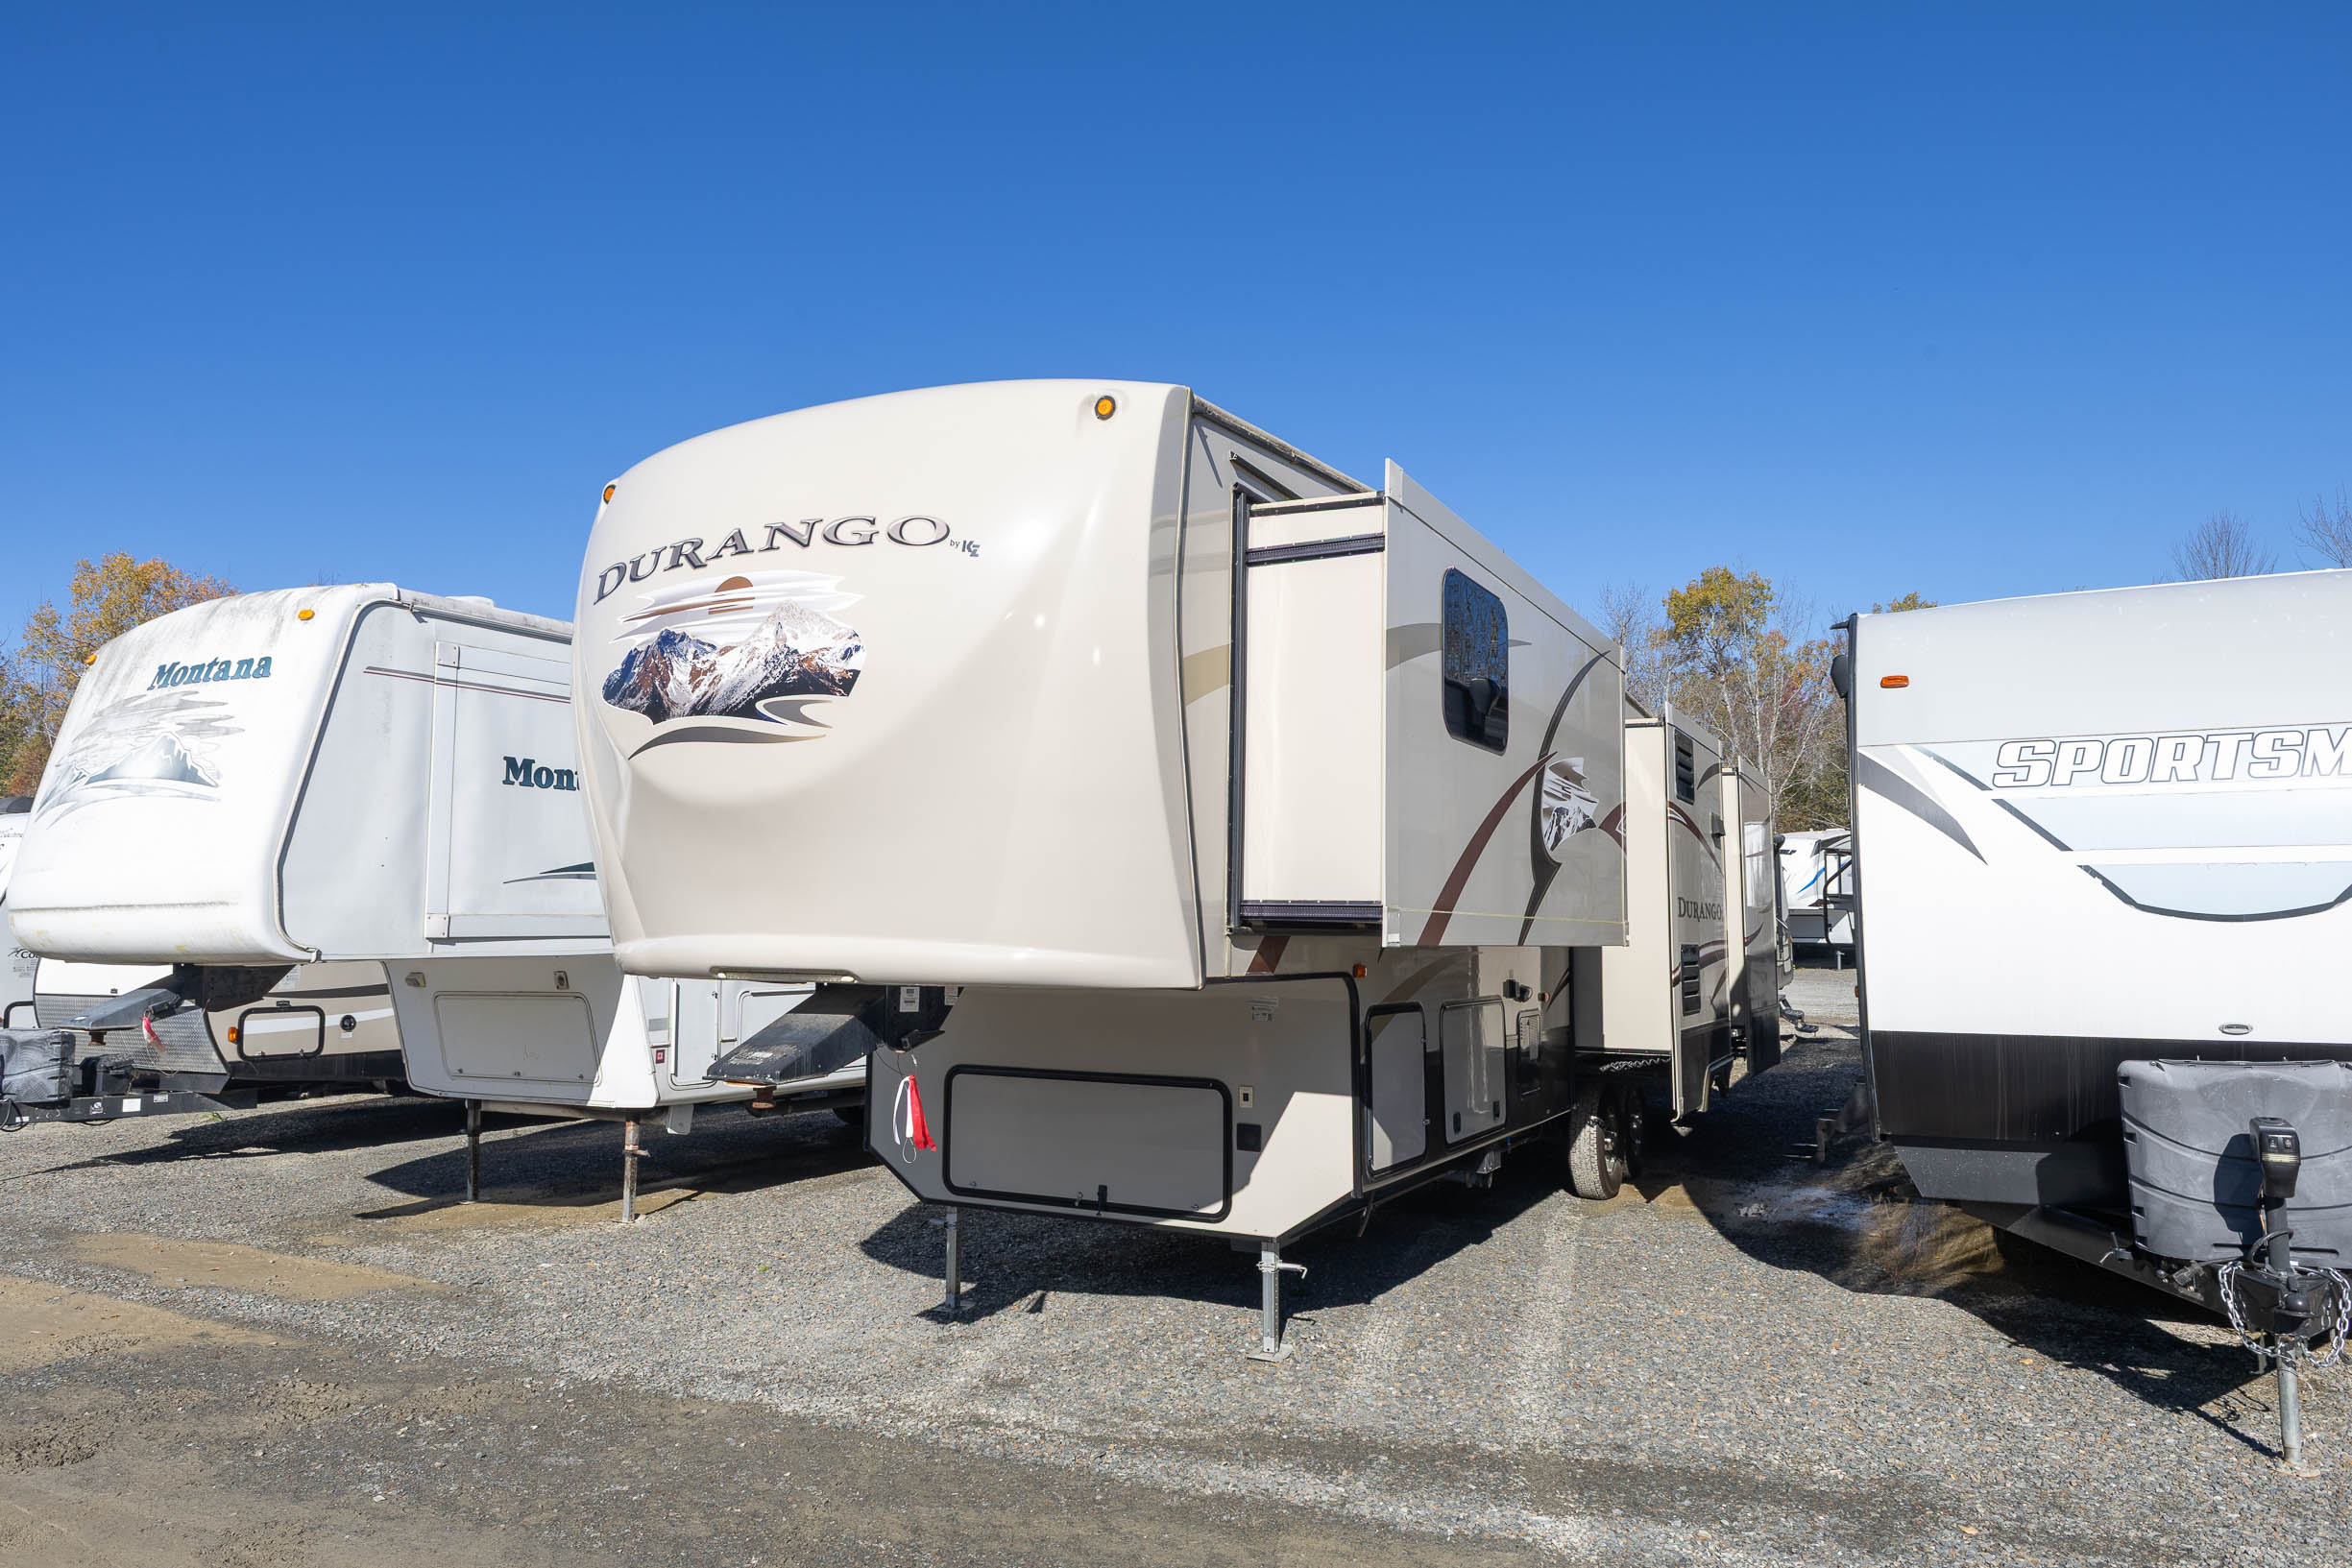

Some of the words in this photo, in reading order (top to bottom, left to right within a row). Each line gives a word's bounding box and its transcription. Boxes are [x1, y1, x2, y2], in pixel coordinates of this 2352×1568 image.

[593, 516, 951, 605] DURANGO
[950, 540, 960, 548] by
[147, 657, 272, 690] Montana
[502, 757, 580, 791] Mon
[1992, 728, 2352, 788] SPORTSM
[1678, 897, 1722, 922] DURANGO
